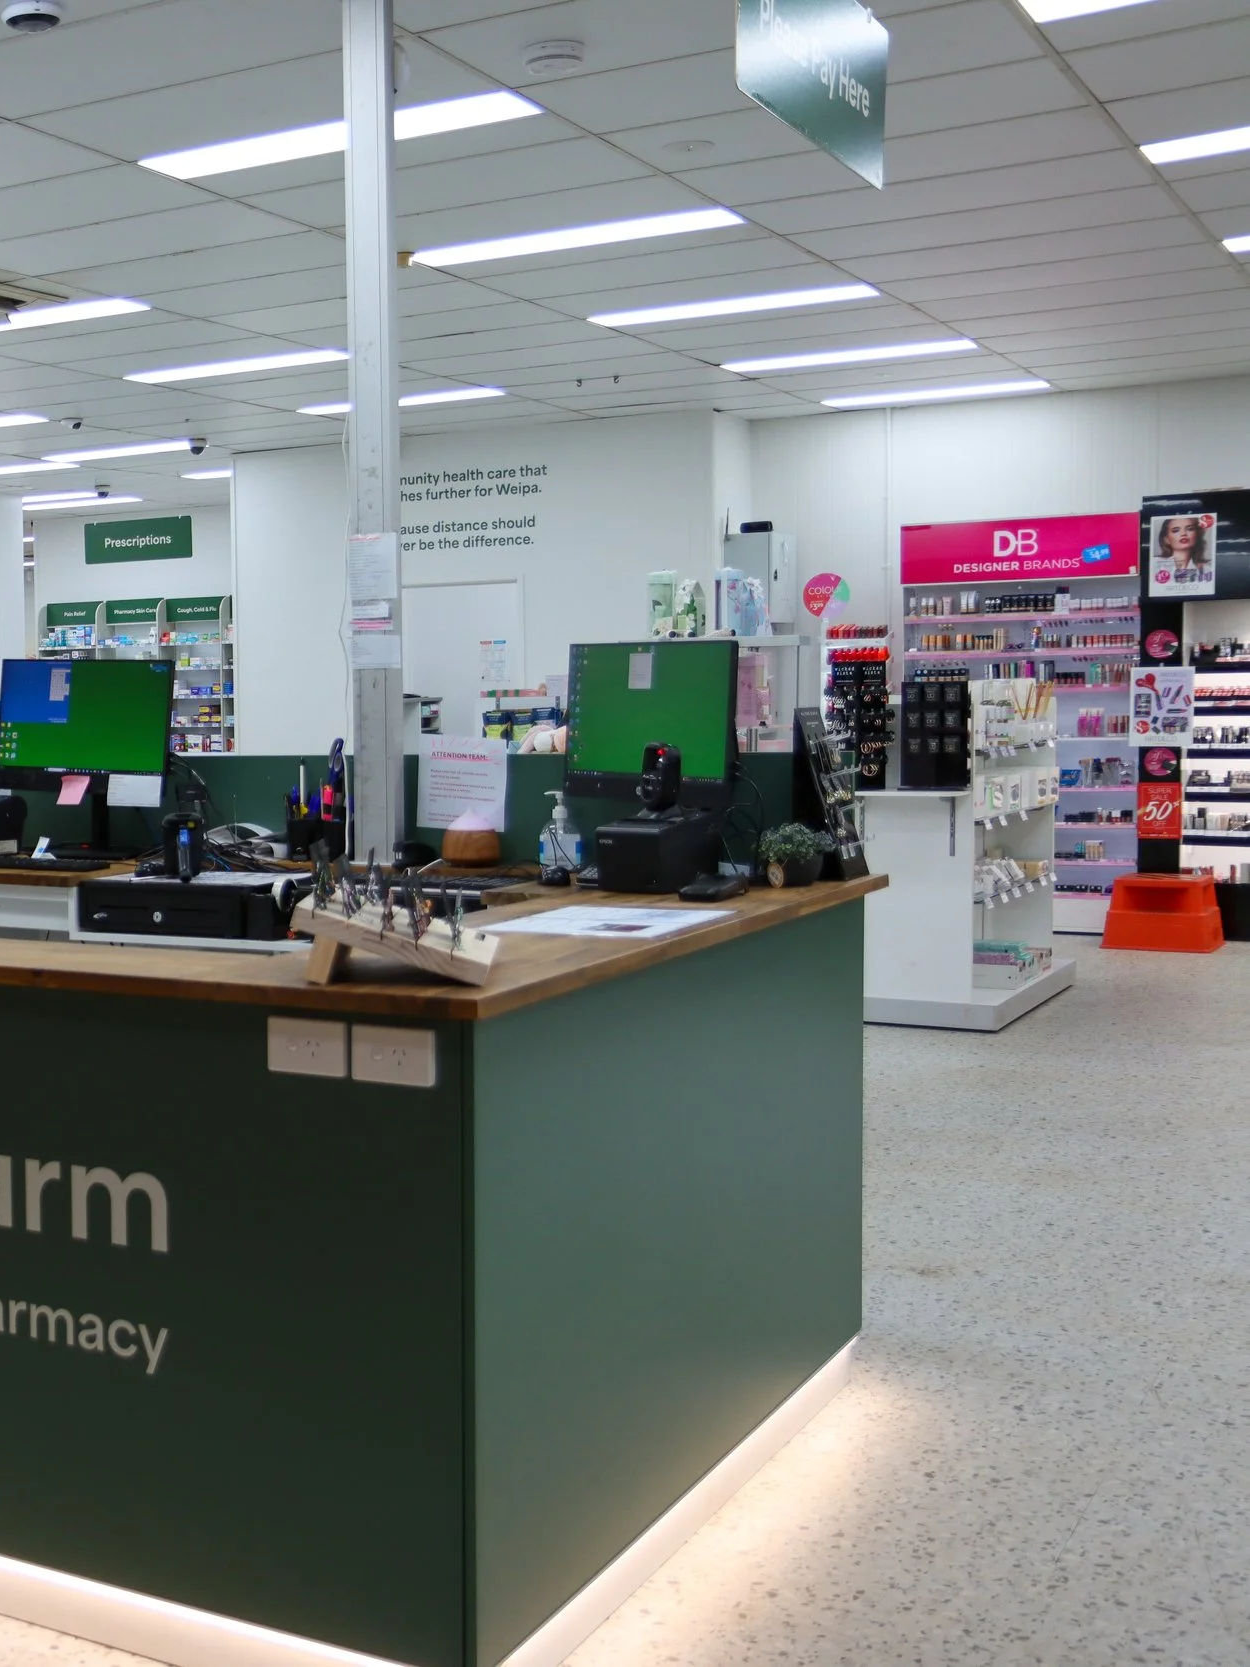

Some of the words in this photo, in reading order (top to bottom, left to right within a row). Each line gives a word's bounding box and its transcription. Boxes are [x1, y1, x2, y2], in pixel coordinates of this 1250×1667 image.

[811, 37, 836, 100] Pay
[838, 57, 870, 118] Here
[443, 468, 484, 483] health
[487, 468, 516, 480] care
[519, 464, 547, 476] that
[425, 487, 471, 500] further
[474, 485, 493, 497] for
[496, 482, 542, 497] Weipa.
[432, 520, 488, 533] distance
[491, 515, 536, 530] should
[104, 534, 172, 549] Prescriptions
[419, 538, 435, 550] be
[438, 537, 459, 549] the
[462, 534, 534, 548] difference.
[993, 529, 1039, 558] DB
[953, 561, 1020, 573] DESIGNER
[1023, 558, 1080, 570] BRANDS
[431, 751, 467, 759] ATTENTION
